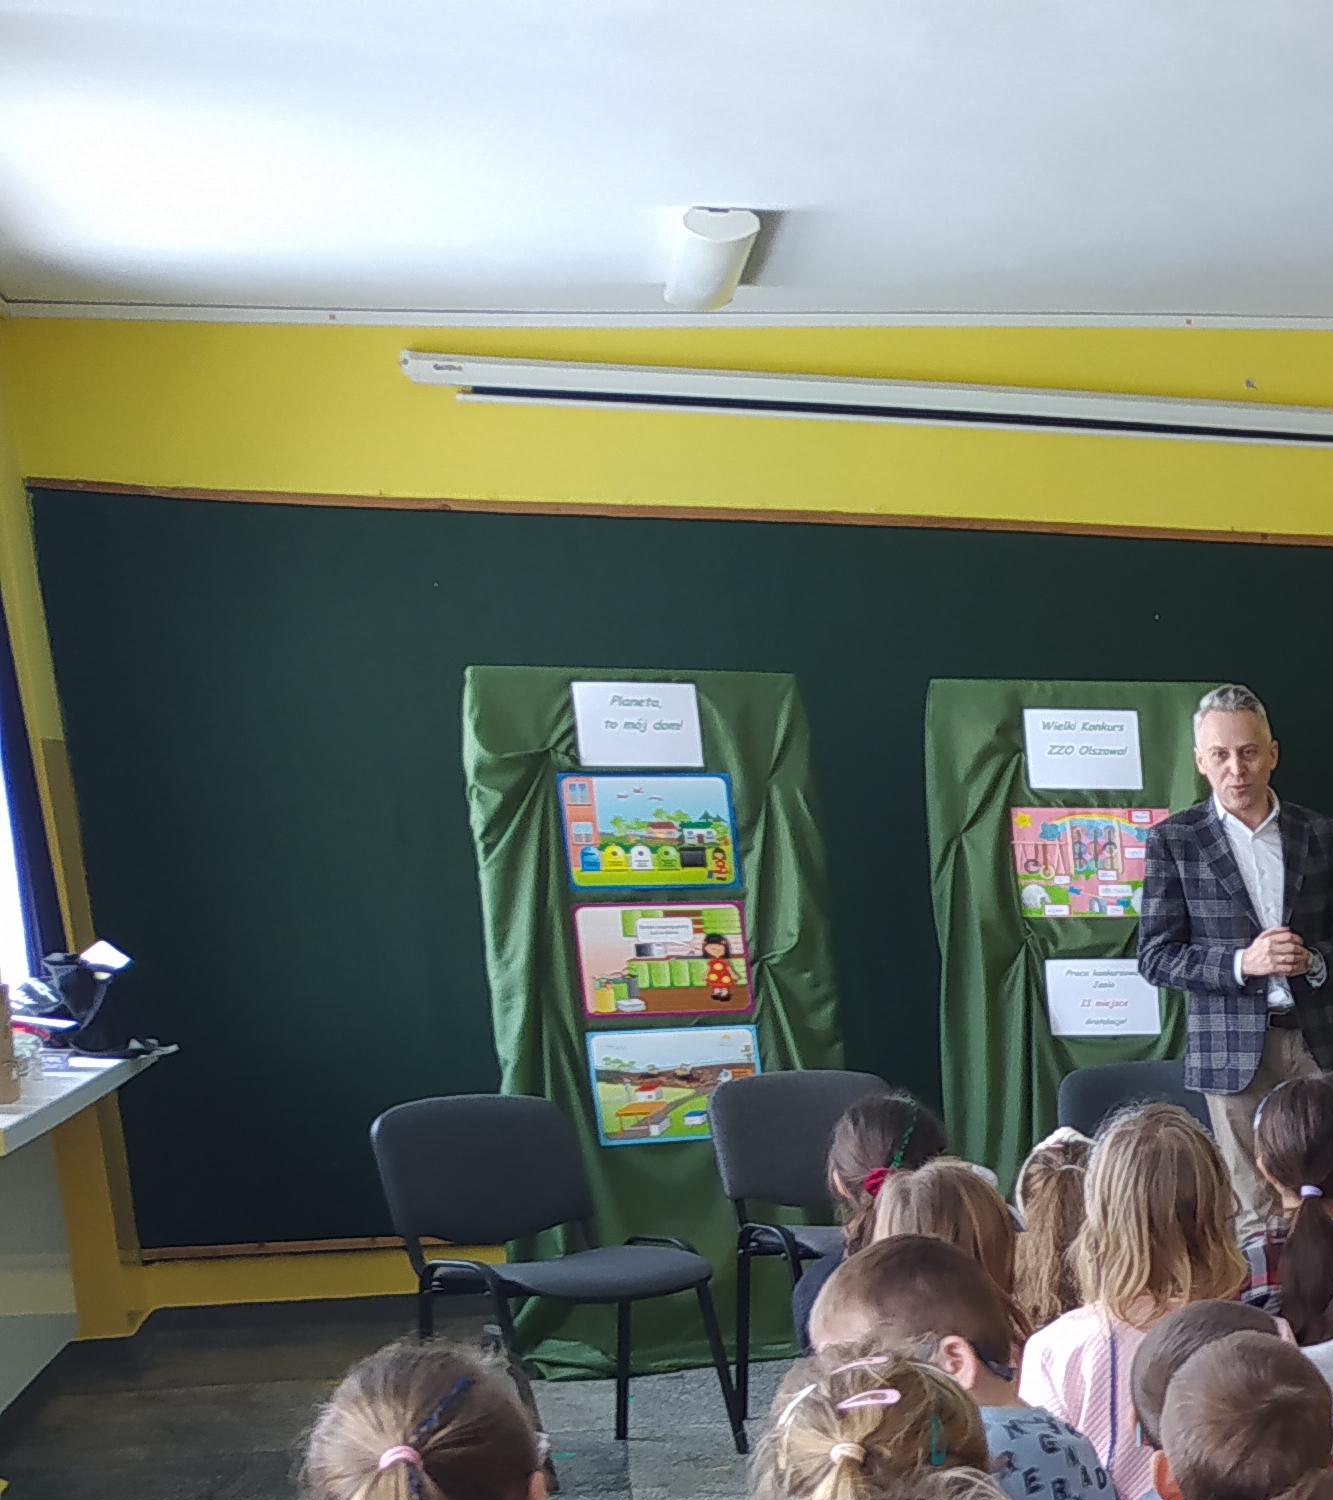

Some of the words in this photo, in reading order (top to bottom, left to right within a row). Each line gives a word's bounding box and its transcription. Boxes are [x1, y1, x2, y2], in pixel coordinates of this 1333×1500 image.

[609, 694, 663, 709] Planeta,
[604, 720, 619, 730] to
[623, 718, 647, 733] mój
[1042, 721, 1077, 731] Wielki
[1081, 721, 1125, 732] Konkurs
[1047, 745, 1075, 755] ZZO
[1079, 745, 1128, 756] Olszowa!
